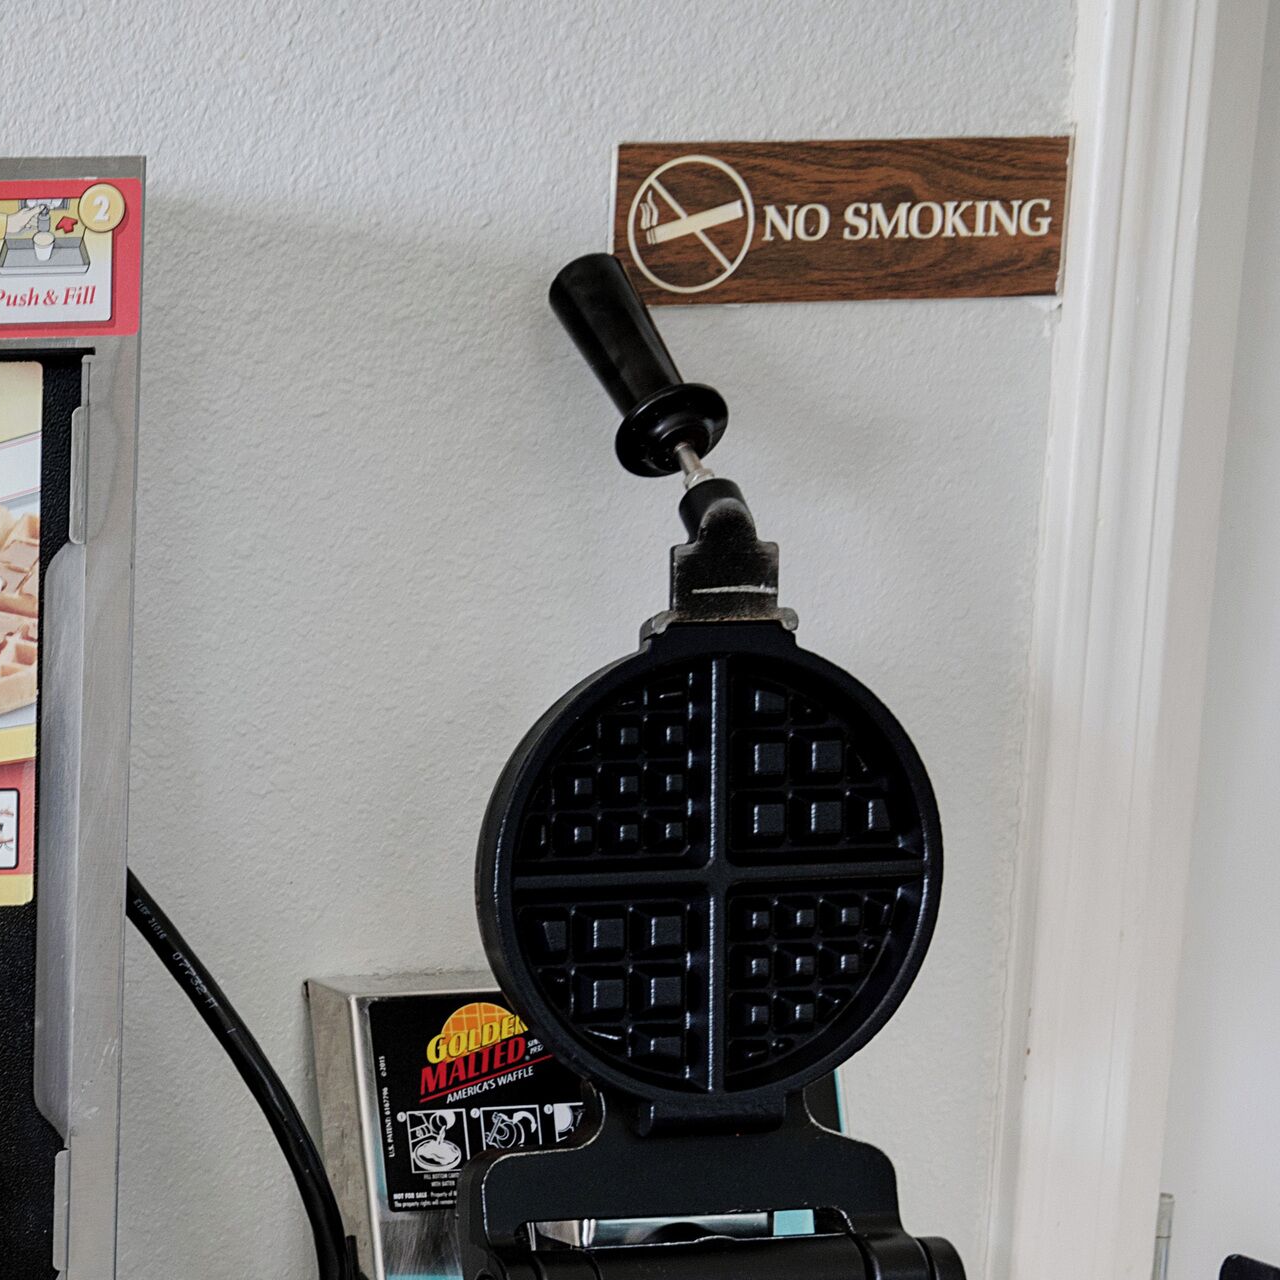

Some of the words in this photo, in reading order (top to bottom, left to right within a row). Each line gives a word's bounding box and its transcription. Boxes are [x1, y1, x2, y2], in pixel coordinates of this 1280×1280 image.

[92, 198, 110, 222] 2
[761, 203, 830, 242] NO
[842, 198, 1053, 242] SMOKING
[42, 290, 59, 305] &
[63, 285, 96, 306] Fill
[205, 996, 219, 1009] FT
[420, 1037, 526, 1095] MALTED
[446, 1079, 496, 1104] AMERICA'S
[497, 1065, 534, 1086] WAFFLE
